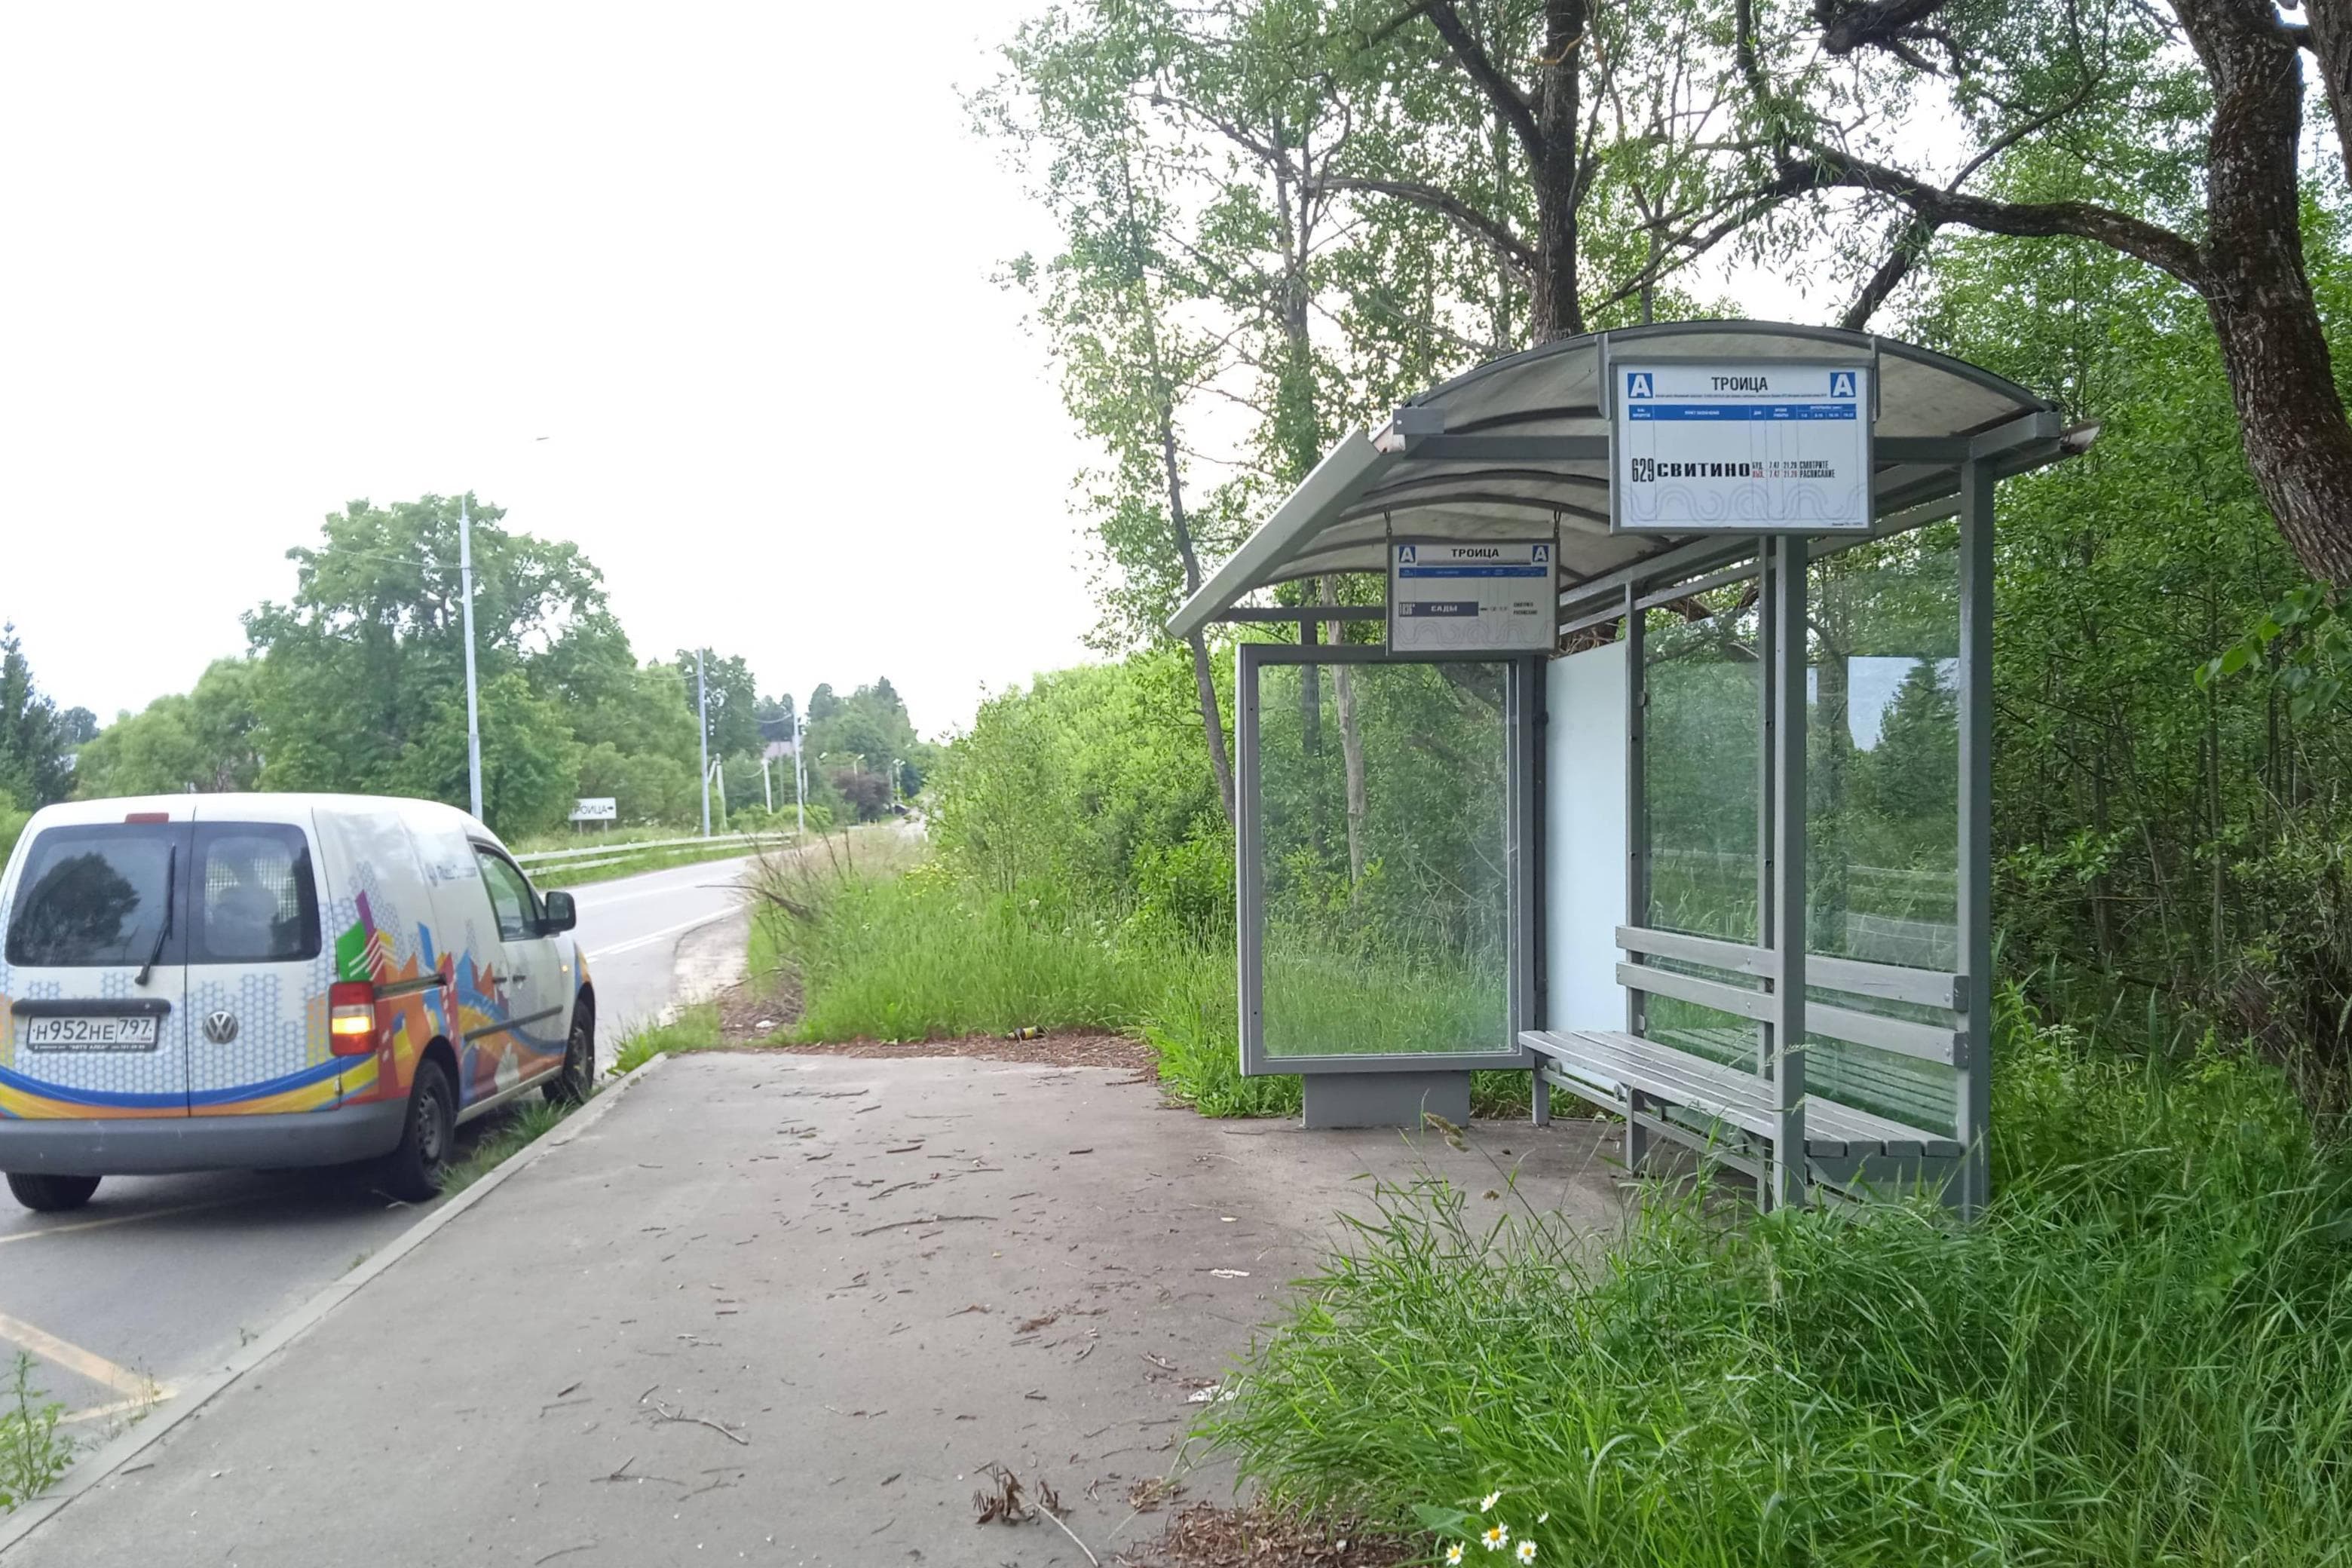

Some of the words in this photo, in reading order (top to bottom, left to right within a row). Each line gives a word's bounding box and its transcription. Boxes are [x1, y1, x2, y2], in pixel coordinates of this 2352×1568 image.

[1631, 375, 1651, 397] А
[1711, 377, 1768, 393] ТРОИЦА
[1833, 374, 1854, 396] А
[1631, 458, 1655, 482] 629
[1657, 463, 1750, 477] СВИТИНО
[1401, 547, 1414, 562] А
[1451, 548, 1499, 559] ТРОИЦА
[1534, 547, 1548, 562] А
[1431, 605, 1458, 613] САДЫ
[120, 1019, 150, 1034] 797
